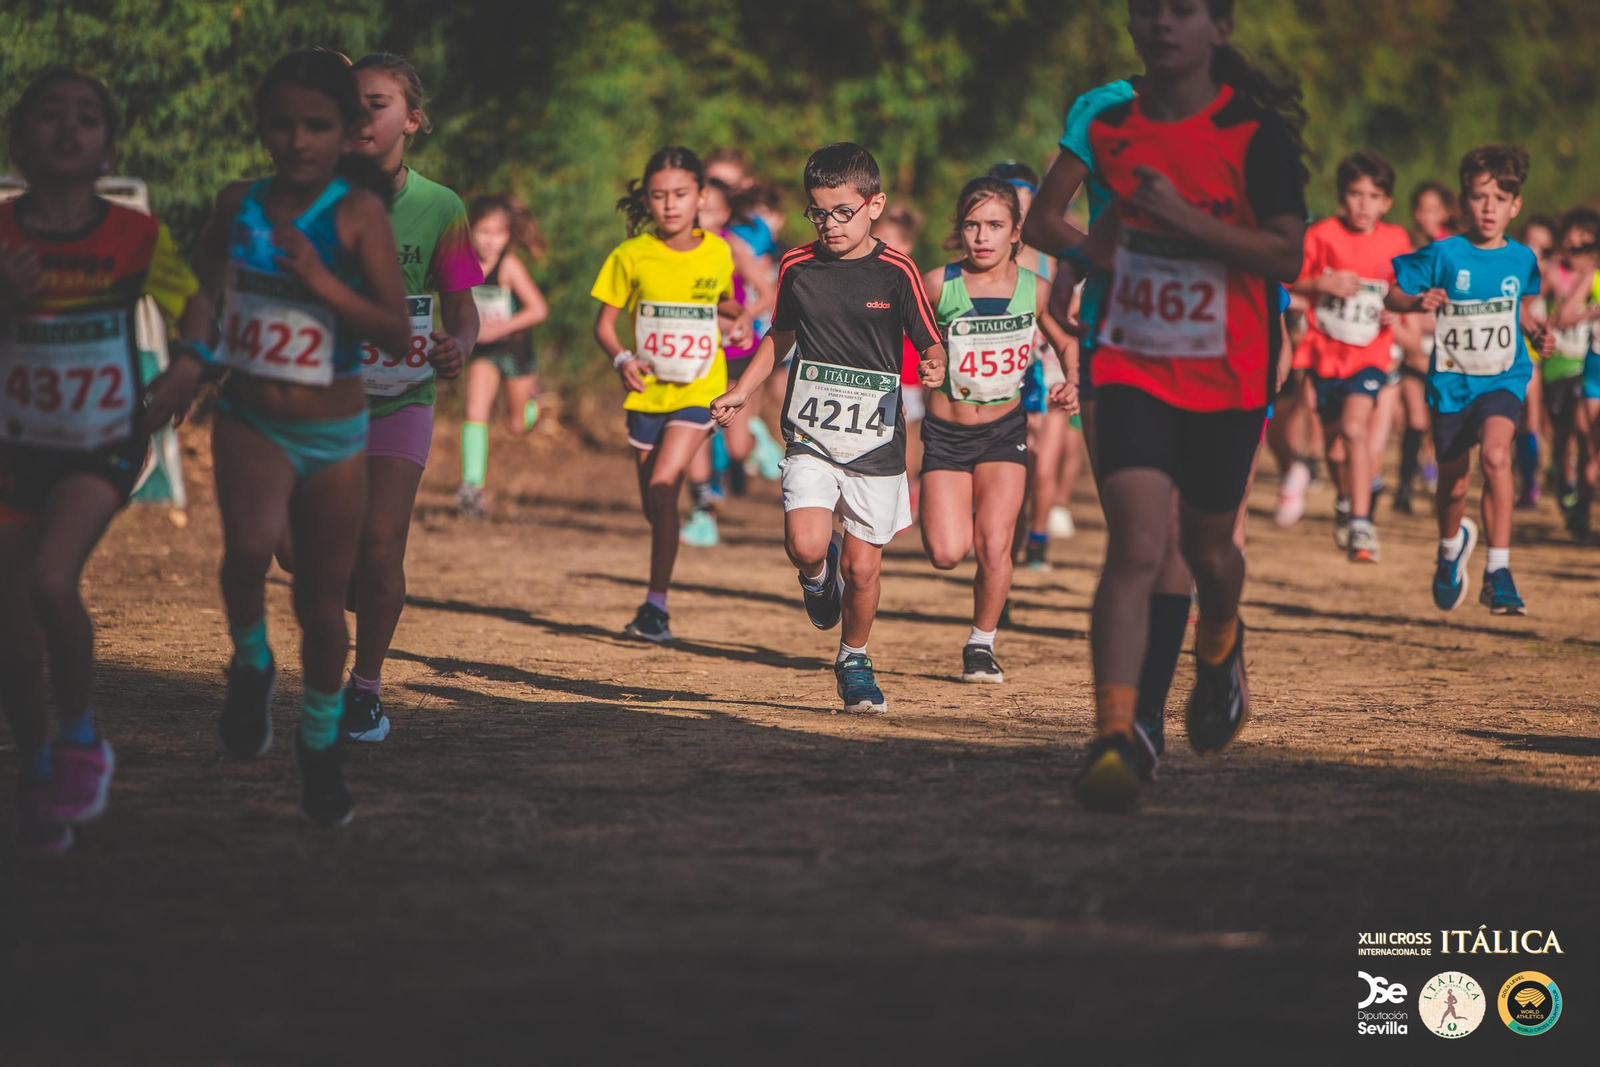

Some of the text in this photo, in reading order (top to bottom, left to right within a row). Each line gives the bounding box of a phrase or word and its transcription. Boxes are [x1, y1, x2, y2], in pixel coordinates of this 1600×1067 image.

[866, 301, 890, 309] adidas
[975, 319, 1018, 332] ITÁLICA
[1444, 325, 1511, 351] 4170
[644, 332, 712, 360] 4529
[959, 344, 1030, 378] 4538
[6, 363, 125, 414] 4372
[824, 369, 872, 386] ITÁLICA
[797, 396, 886, 437] 4214
